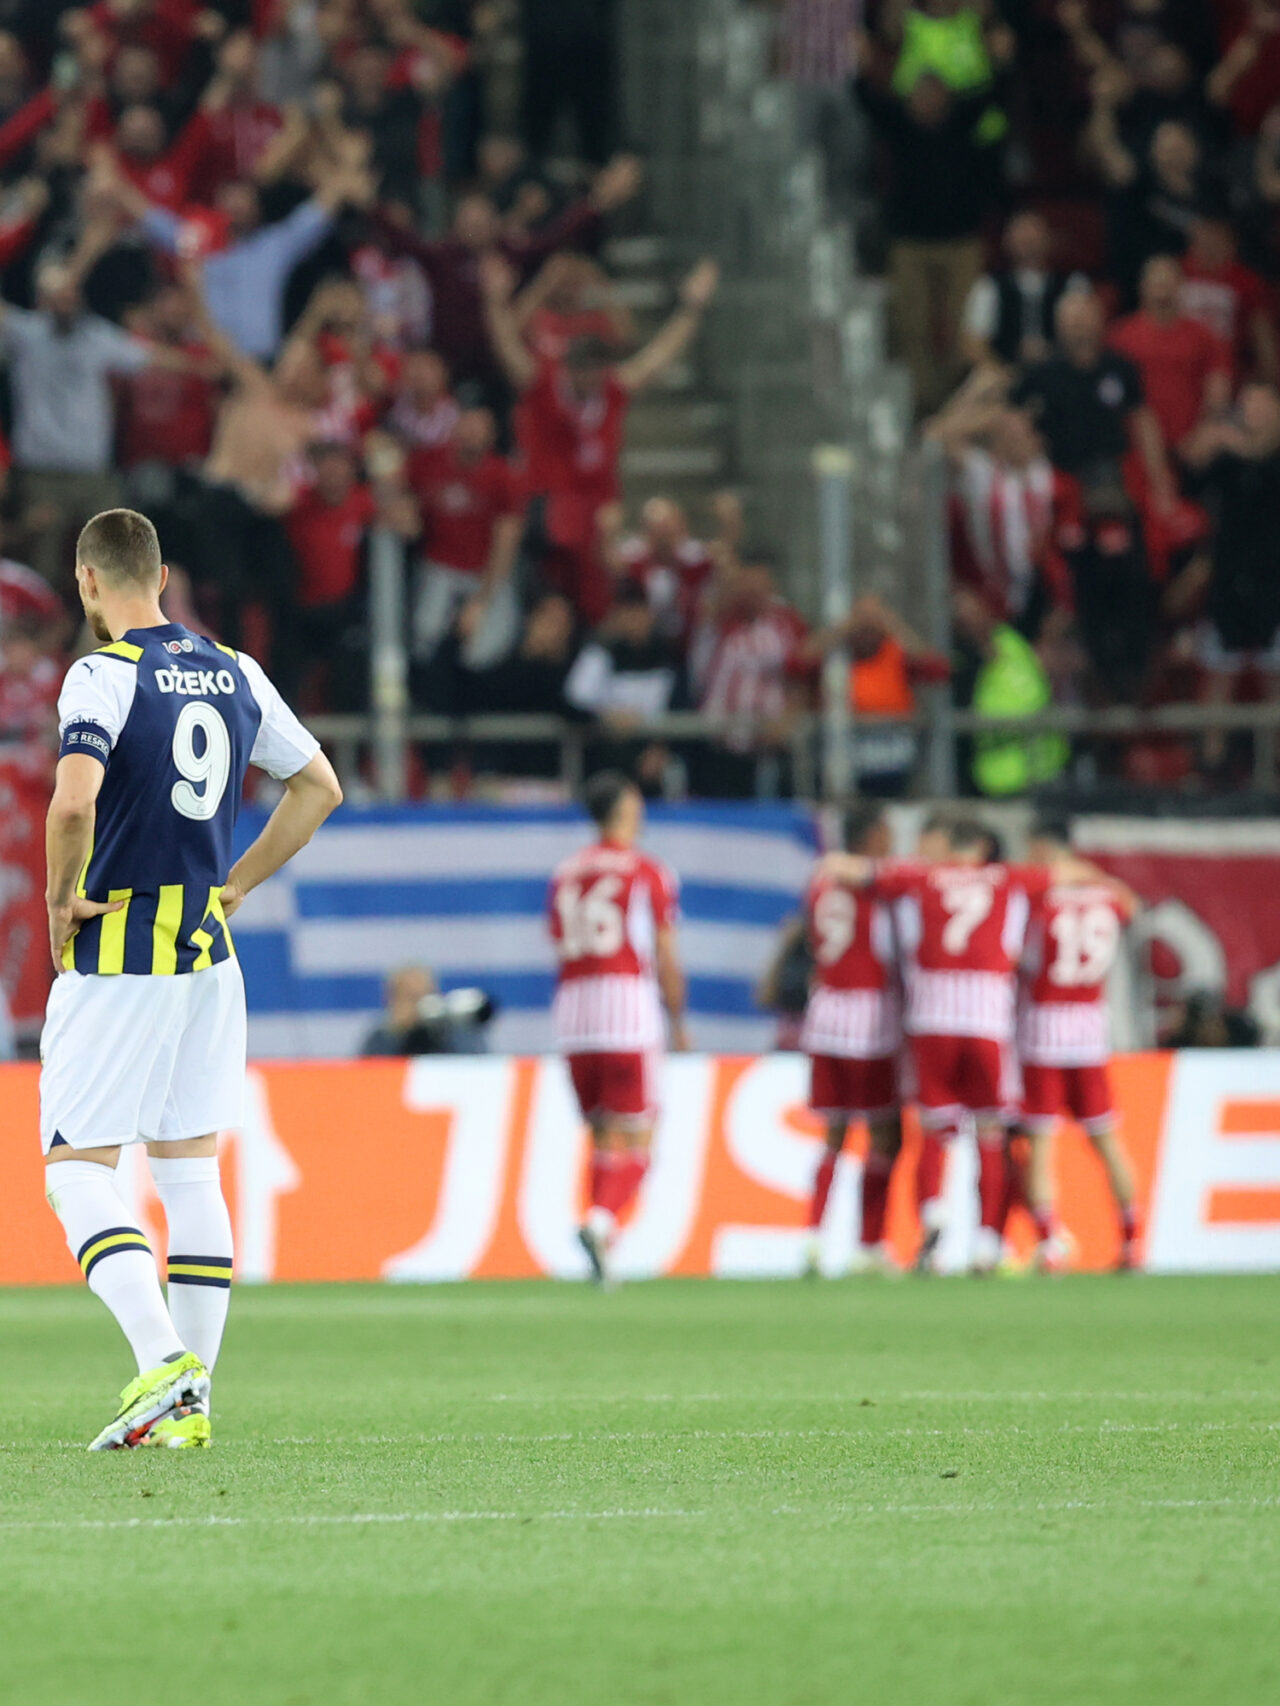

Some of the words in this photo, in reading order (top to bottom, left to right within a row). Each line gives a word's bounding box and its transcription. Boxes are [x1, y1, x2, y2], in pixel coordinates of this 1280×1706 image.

[154, 664, 235, 695] DŽEKO
[171, 700, 231, 821] 9
[553, 872, 624, 962] 16
[940, 880, 995, 956] 7
[1048, 902, 1119, 987] 19
